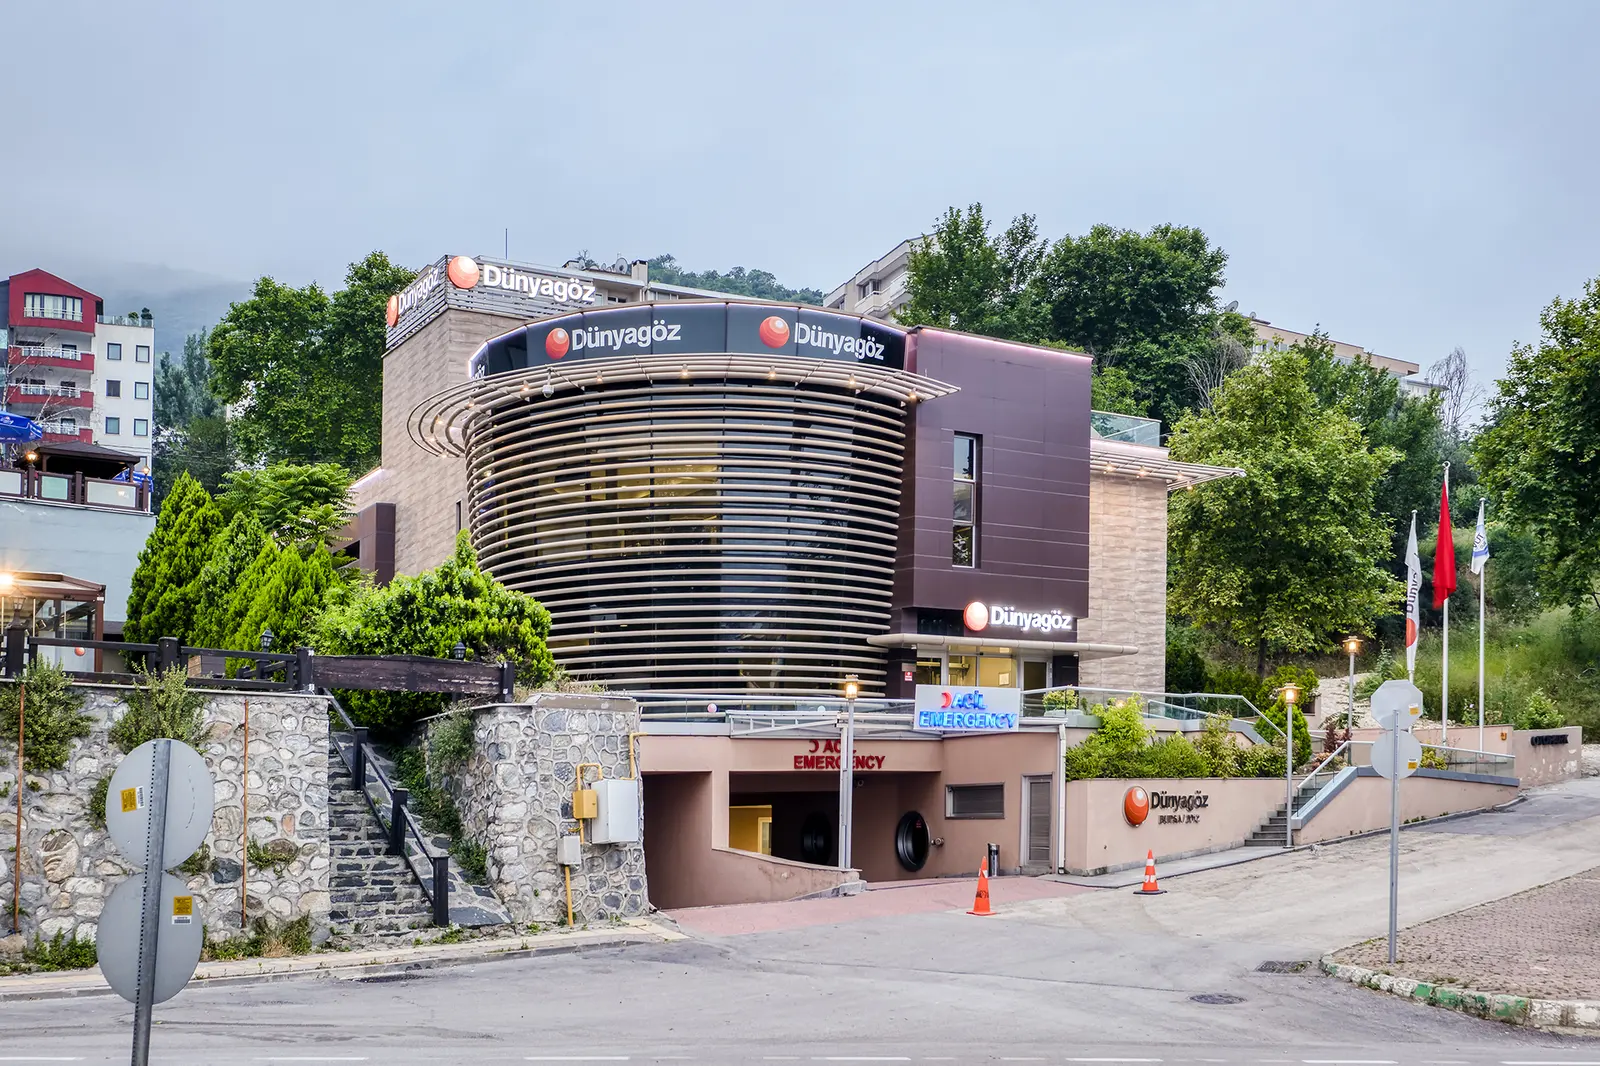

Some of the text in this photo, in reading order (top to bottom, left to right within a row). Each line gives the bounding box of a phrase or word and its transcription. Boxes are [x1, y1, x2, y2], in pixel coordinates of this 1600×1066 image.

[398, 267, 440, 316] Dünyagöz
[483, 264, 596, 303] Dünyagöz
[571, 319, 681, 351] Dünyagöz
[794, 322, 885, 360] Dünyagöz
[990, 605, 1072, 632] Dünyagöz
[919, 711, 1018, 728] EMERGENCY
[1150, 790, 1209, 812] Dünyagöz
